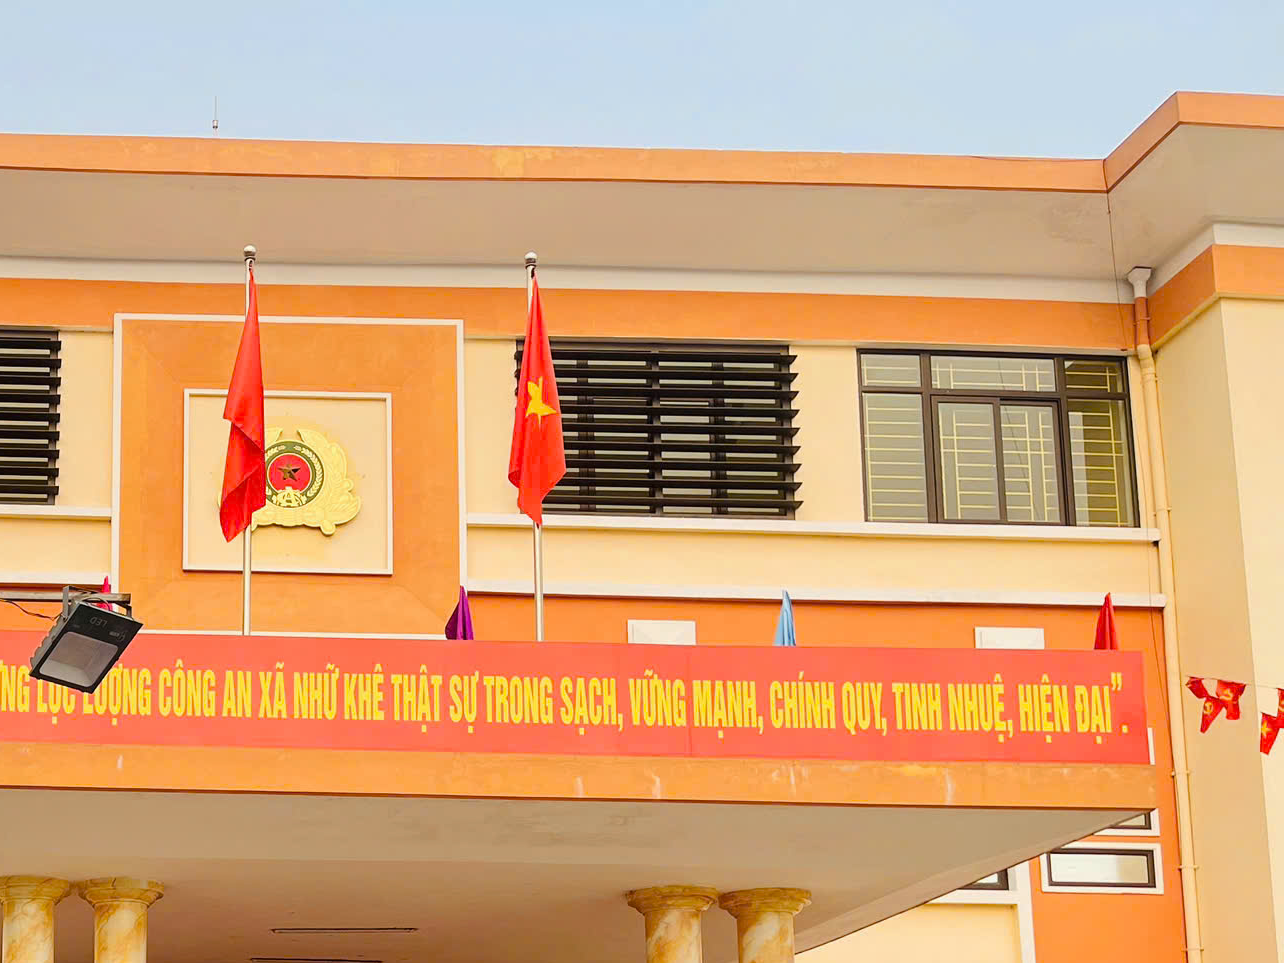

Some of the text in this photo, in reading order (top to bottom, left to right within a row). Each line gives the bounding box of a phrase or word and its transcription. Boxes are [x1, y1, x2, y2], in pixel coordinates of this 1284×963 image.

[89, 616, 108, 628] LED
[158, 659, 216, 717] CÔNG
[222, 670, 252, 718] AN
[258, 661, 288, 719] XÃ
[293, 663, 340, 720] NHỮ
[343, 663, 385, 721] KHÊ
[390, 664, 443, 733] THẬT
[448, 671, 480, 734] SỰ
[483, 675, 554, 724] TRONG
[559, 677, 624, 736] SẠCH,
[628, 669, 687, 727] VỮNG
[692, 680, 765, 739] MẠNH,
[769, 671, 837, 729] CHÍNH
[841, 682, 888, 737] QUY,
[891, 682, 943, 731] TINH
[947, 673, 1014, 743] NHUỆ,
[1017, 674, 1071, 744] HIỆN
